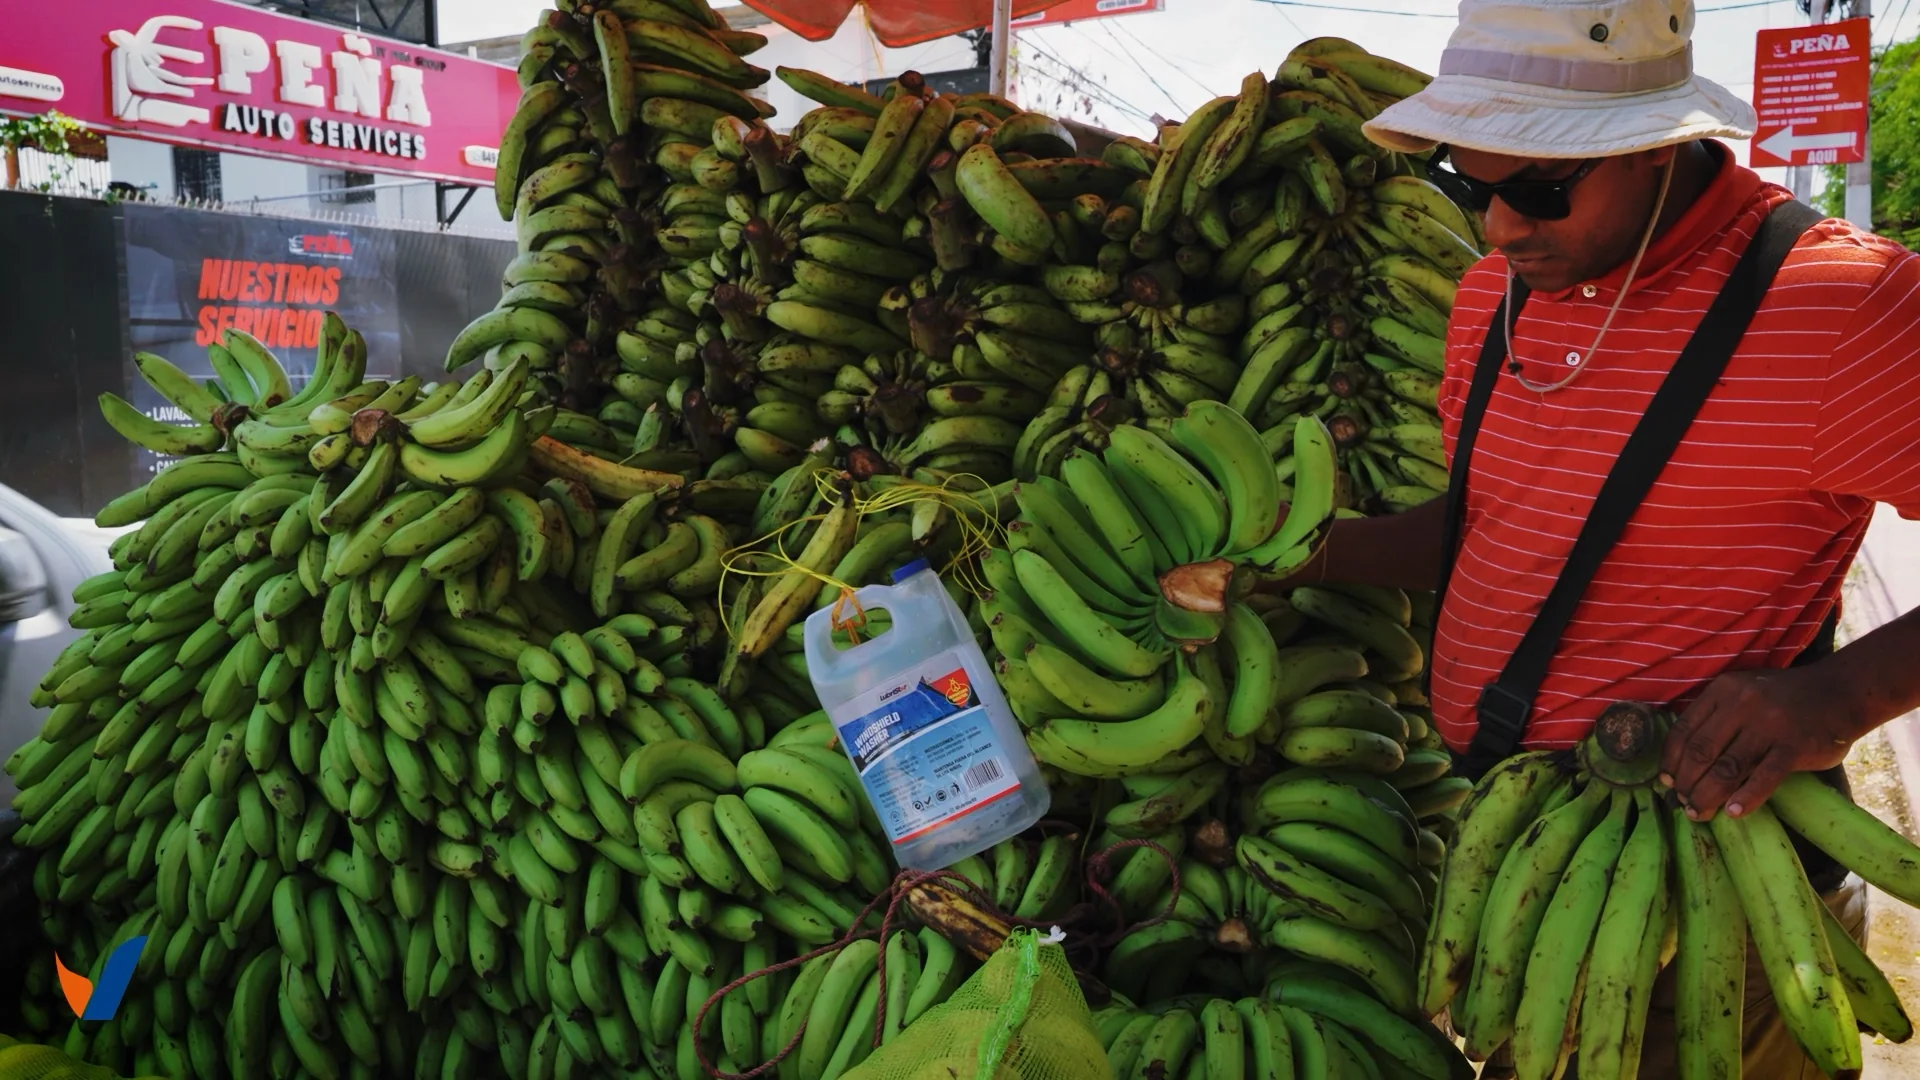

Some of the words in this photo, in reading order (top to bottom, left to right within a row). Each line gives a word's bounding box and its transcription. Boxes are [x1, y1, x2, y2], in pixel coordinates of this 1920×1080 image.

[1790, 34, 1850, 54] PEÑA
[213, 26, 431, 127] PEÑA
[225, 103, 294, 140] AUTO
[310, 117, 427, 160] SERVICES
[1807, 149, 1838, 164] AQUI
[198, 258, 341, 305] NUESTROS
[854, 711, 900, 749] WINDSHIELD
[858, 728, 890, 759] WASHER
